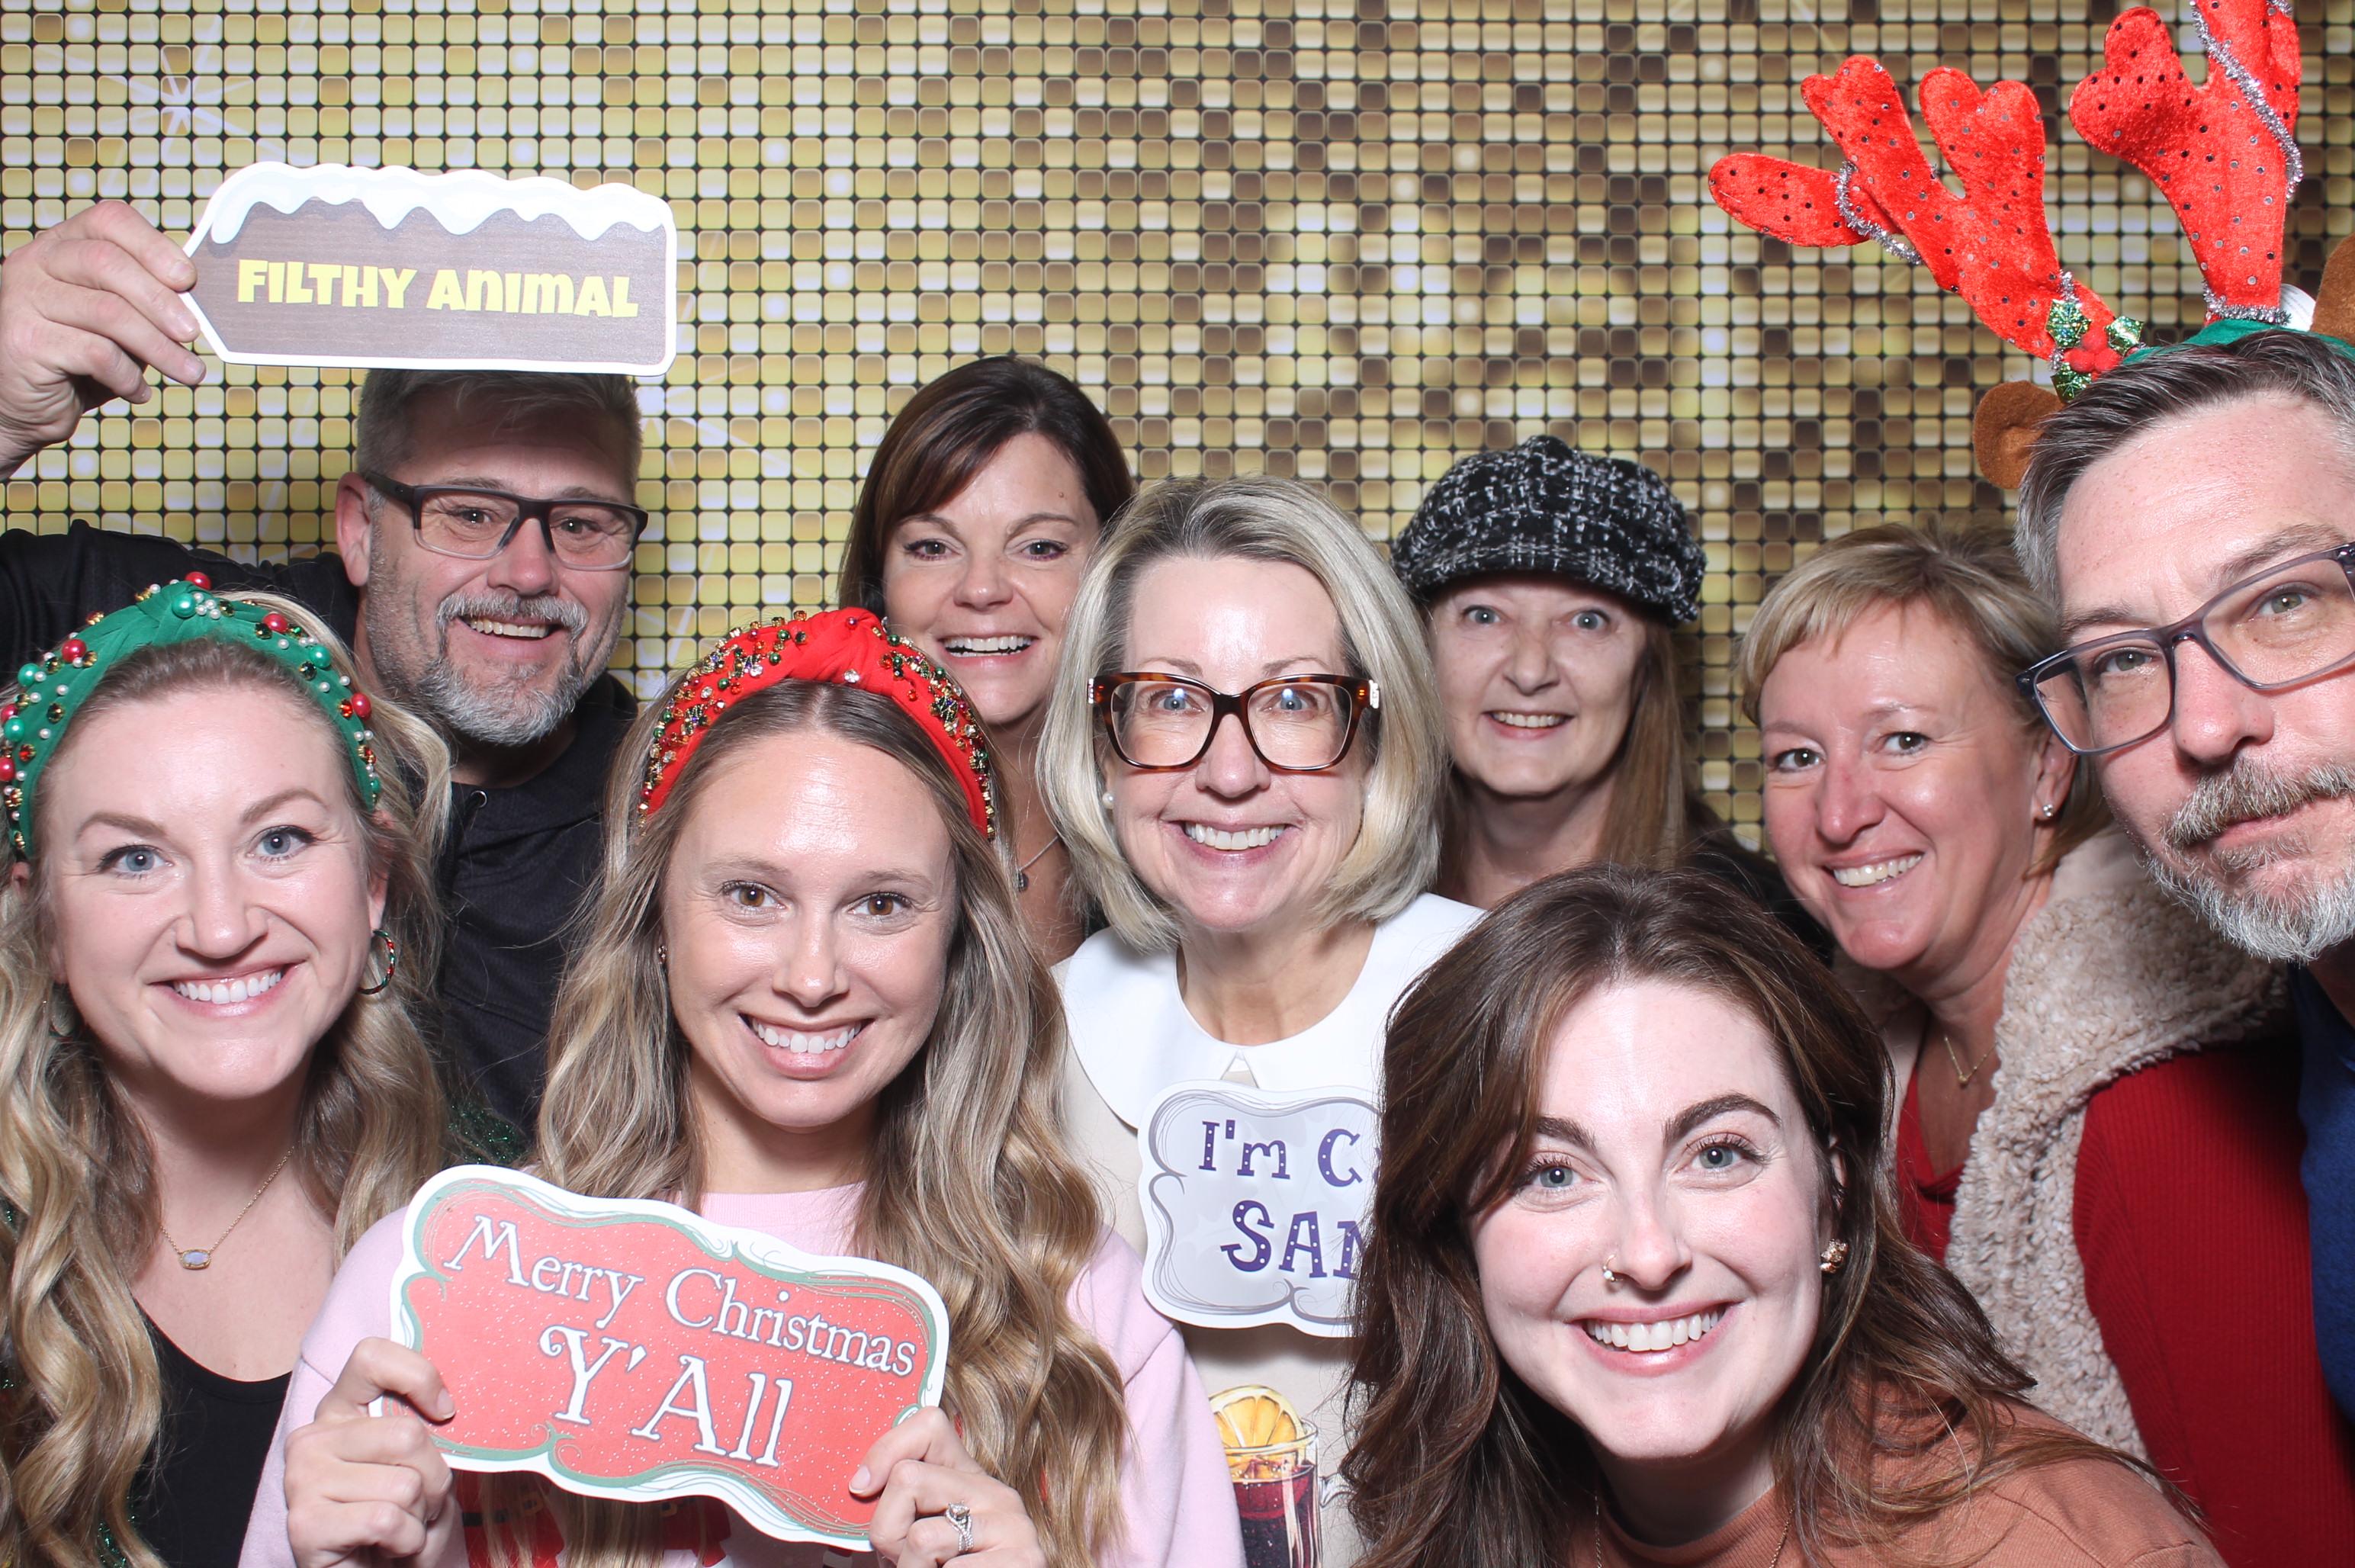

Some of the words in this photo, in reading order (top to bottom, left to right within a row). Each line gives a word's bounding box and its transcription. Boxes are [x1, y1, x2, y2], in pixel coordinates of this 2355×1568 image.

[237, 259, 418, 308] FILTHY
[1198, 1119, 1291, 1180] I'm
[444, 1214, 644, 1329] Merry
[666, 1268, 916, 1376] Christmas
[539, 1325, 792, 1468] Y'All
